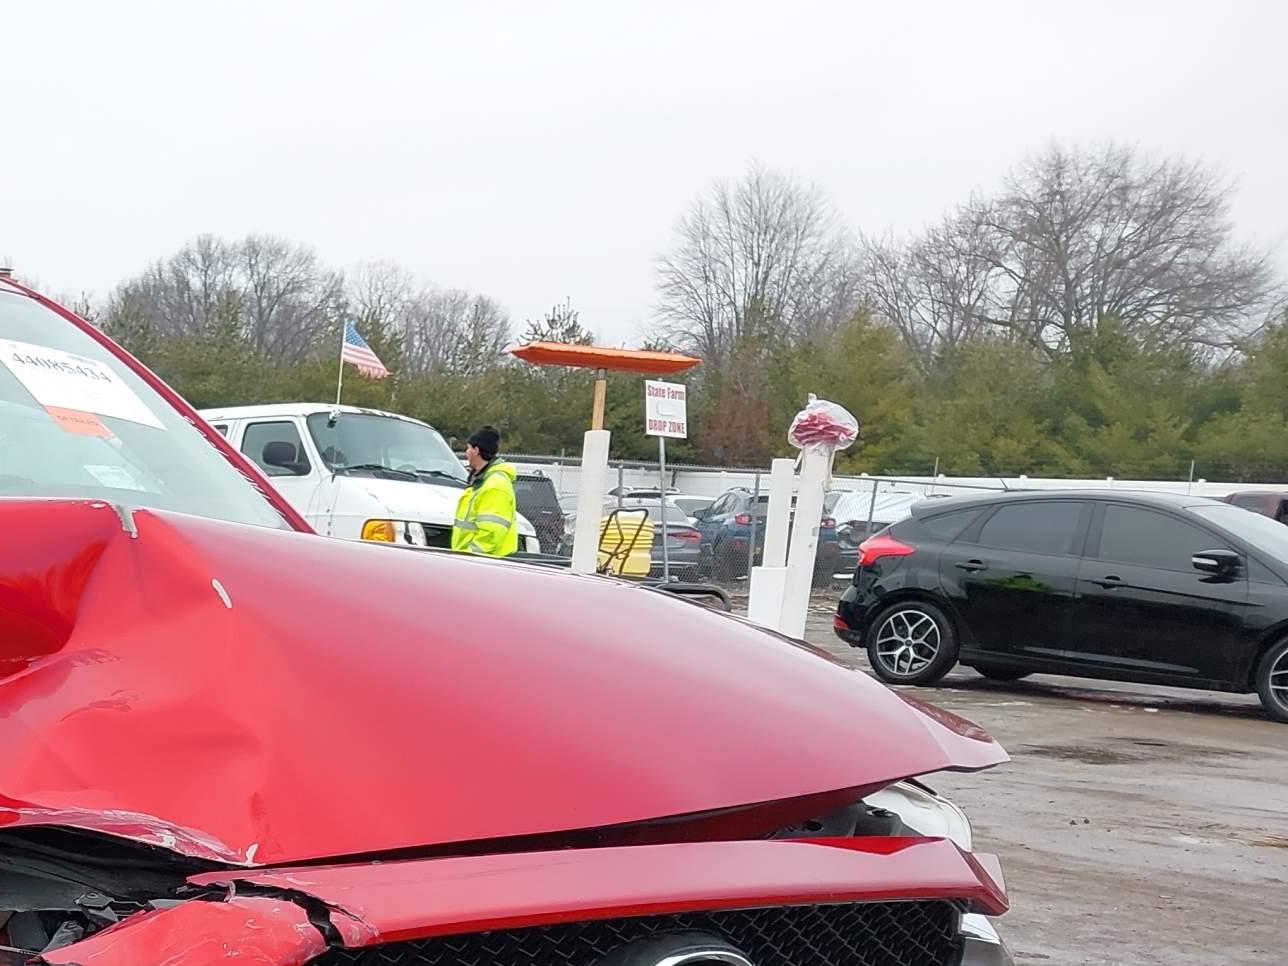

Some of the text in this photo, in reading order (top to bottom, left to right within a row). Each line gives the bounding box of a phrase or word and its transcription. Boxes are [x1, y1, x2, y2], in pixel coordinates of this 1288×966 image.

[648, 385, 684, 400] State Farm
[649, 419, 685, 434] DROP ZONE
